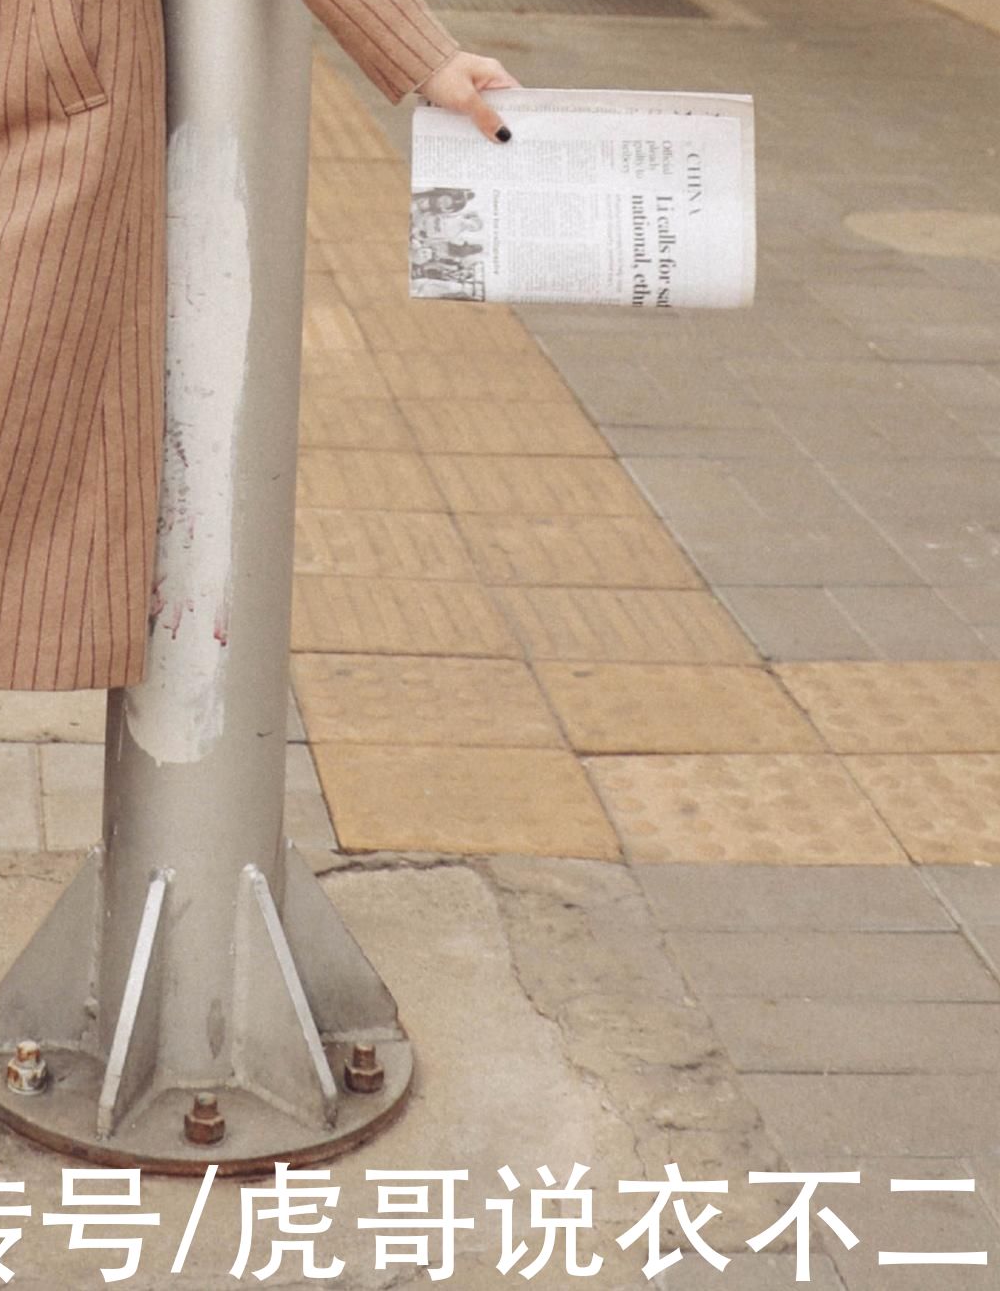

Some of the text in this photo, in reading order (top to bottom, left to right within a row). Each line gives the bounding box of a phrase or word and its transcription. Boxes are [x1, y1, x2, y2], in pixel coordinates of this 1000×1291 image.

[686, 152, 703, 216] CHINA
[656, 196, 674, 212] Li
[657, 216, 678, 254] calls
[658, 259, 678, 284] for
